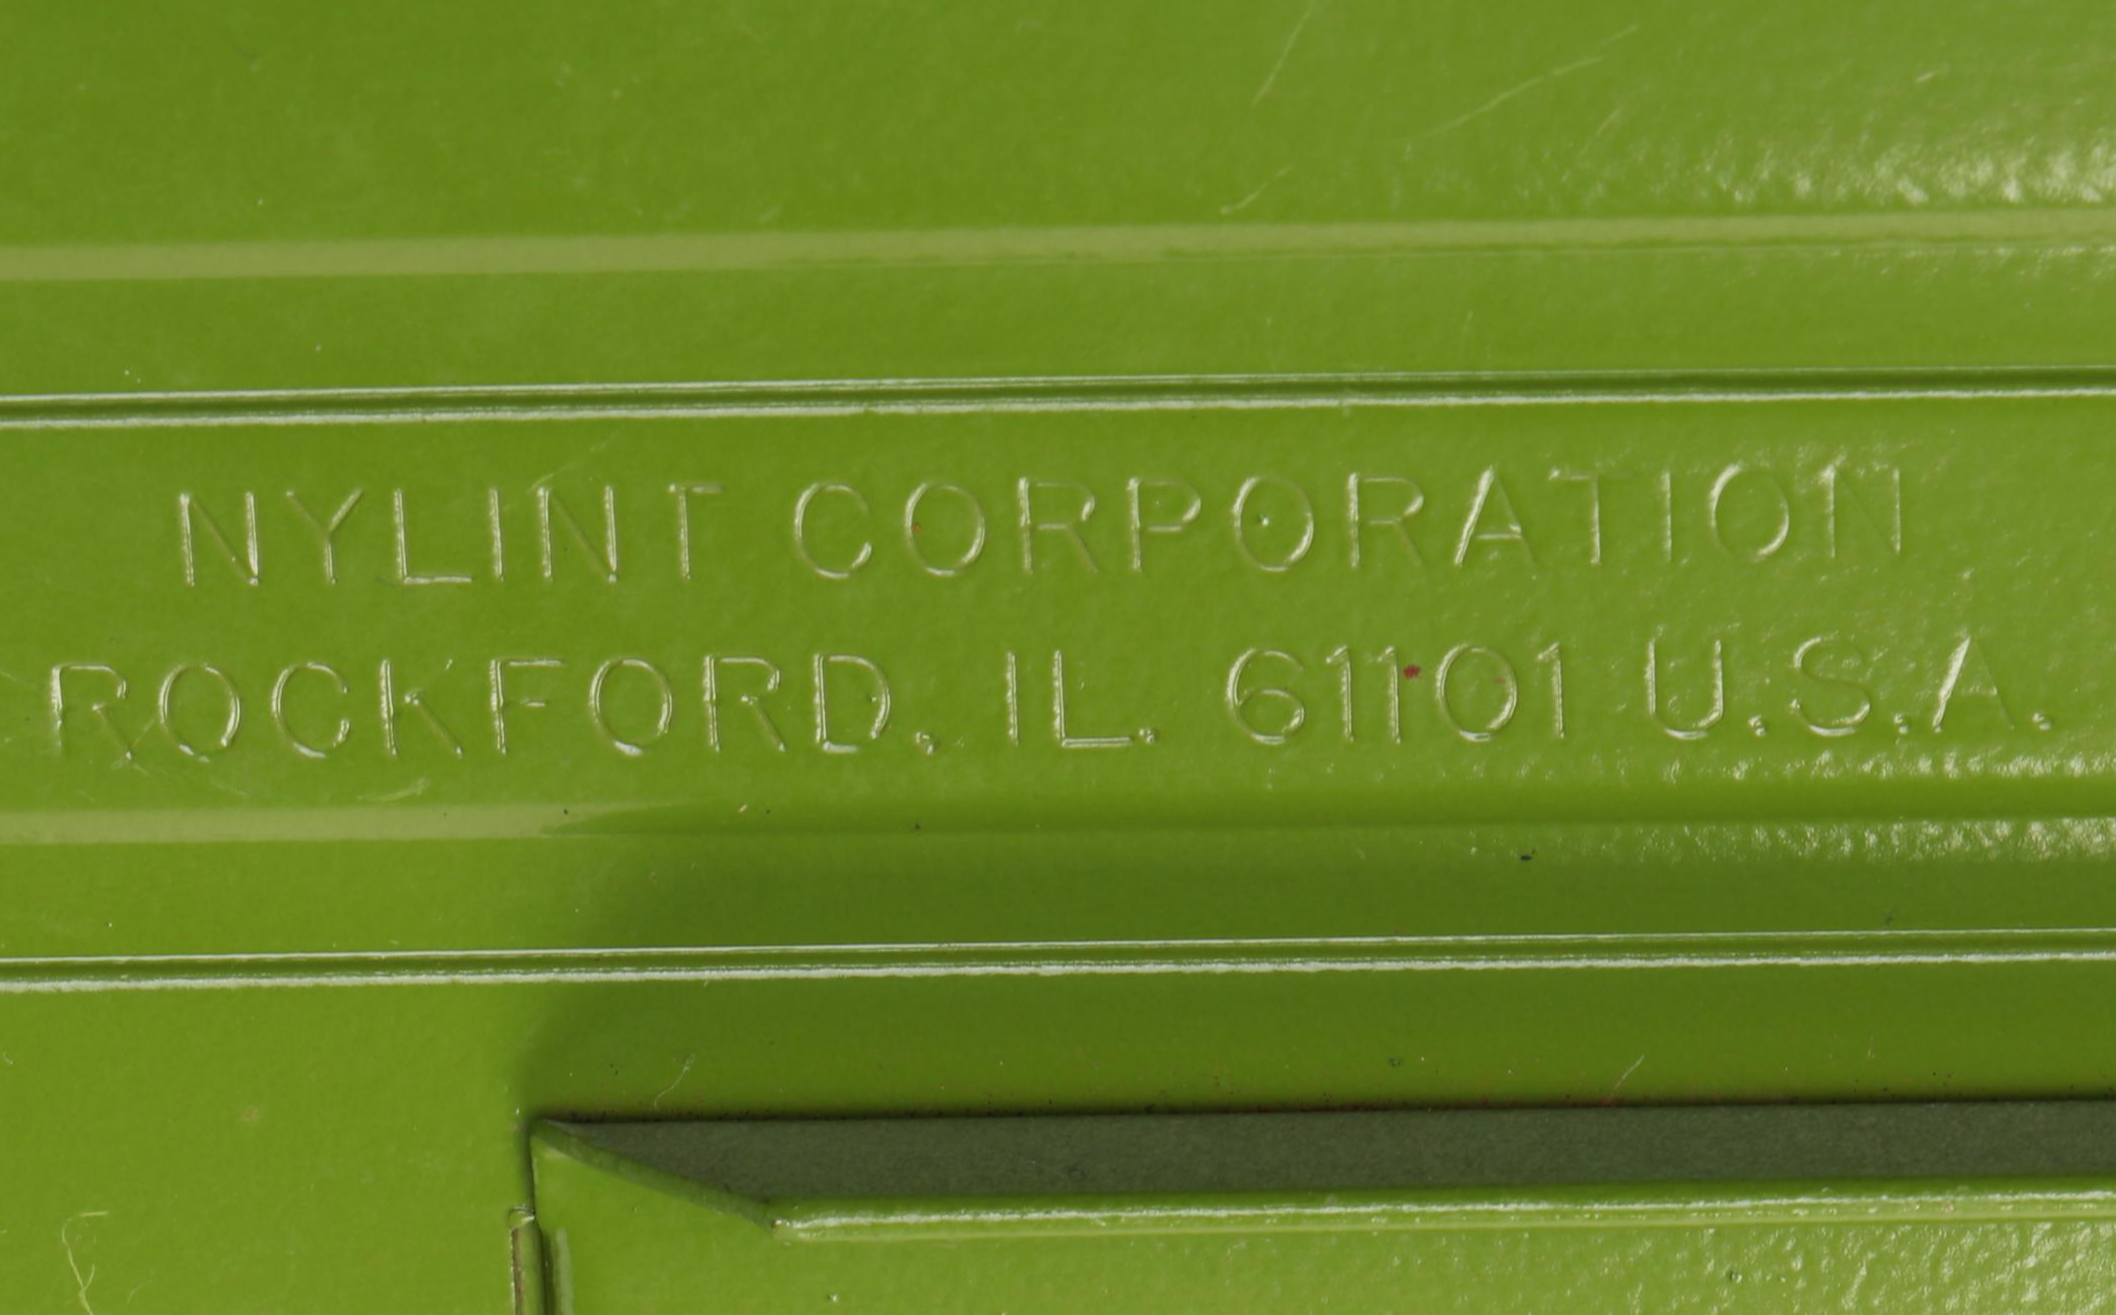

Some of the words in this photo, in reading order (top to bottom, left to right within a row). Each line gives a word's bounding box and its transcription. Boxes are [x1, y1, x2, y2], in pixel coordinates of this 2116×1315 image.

[177, 484, 726, 588] NYLINT
[791, 464, 1903, 581] CORPORATION
[1003, 648, 1161, 749] IL.
[1223, 642, 1568, 745] 61101
[1640, 632, 2055, 742] U.S.A.
